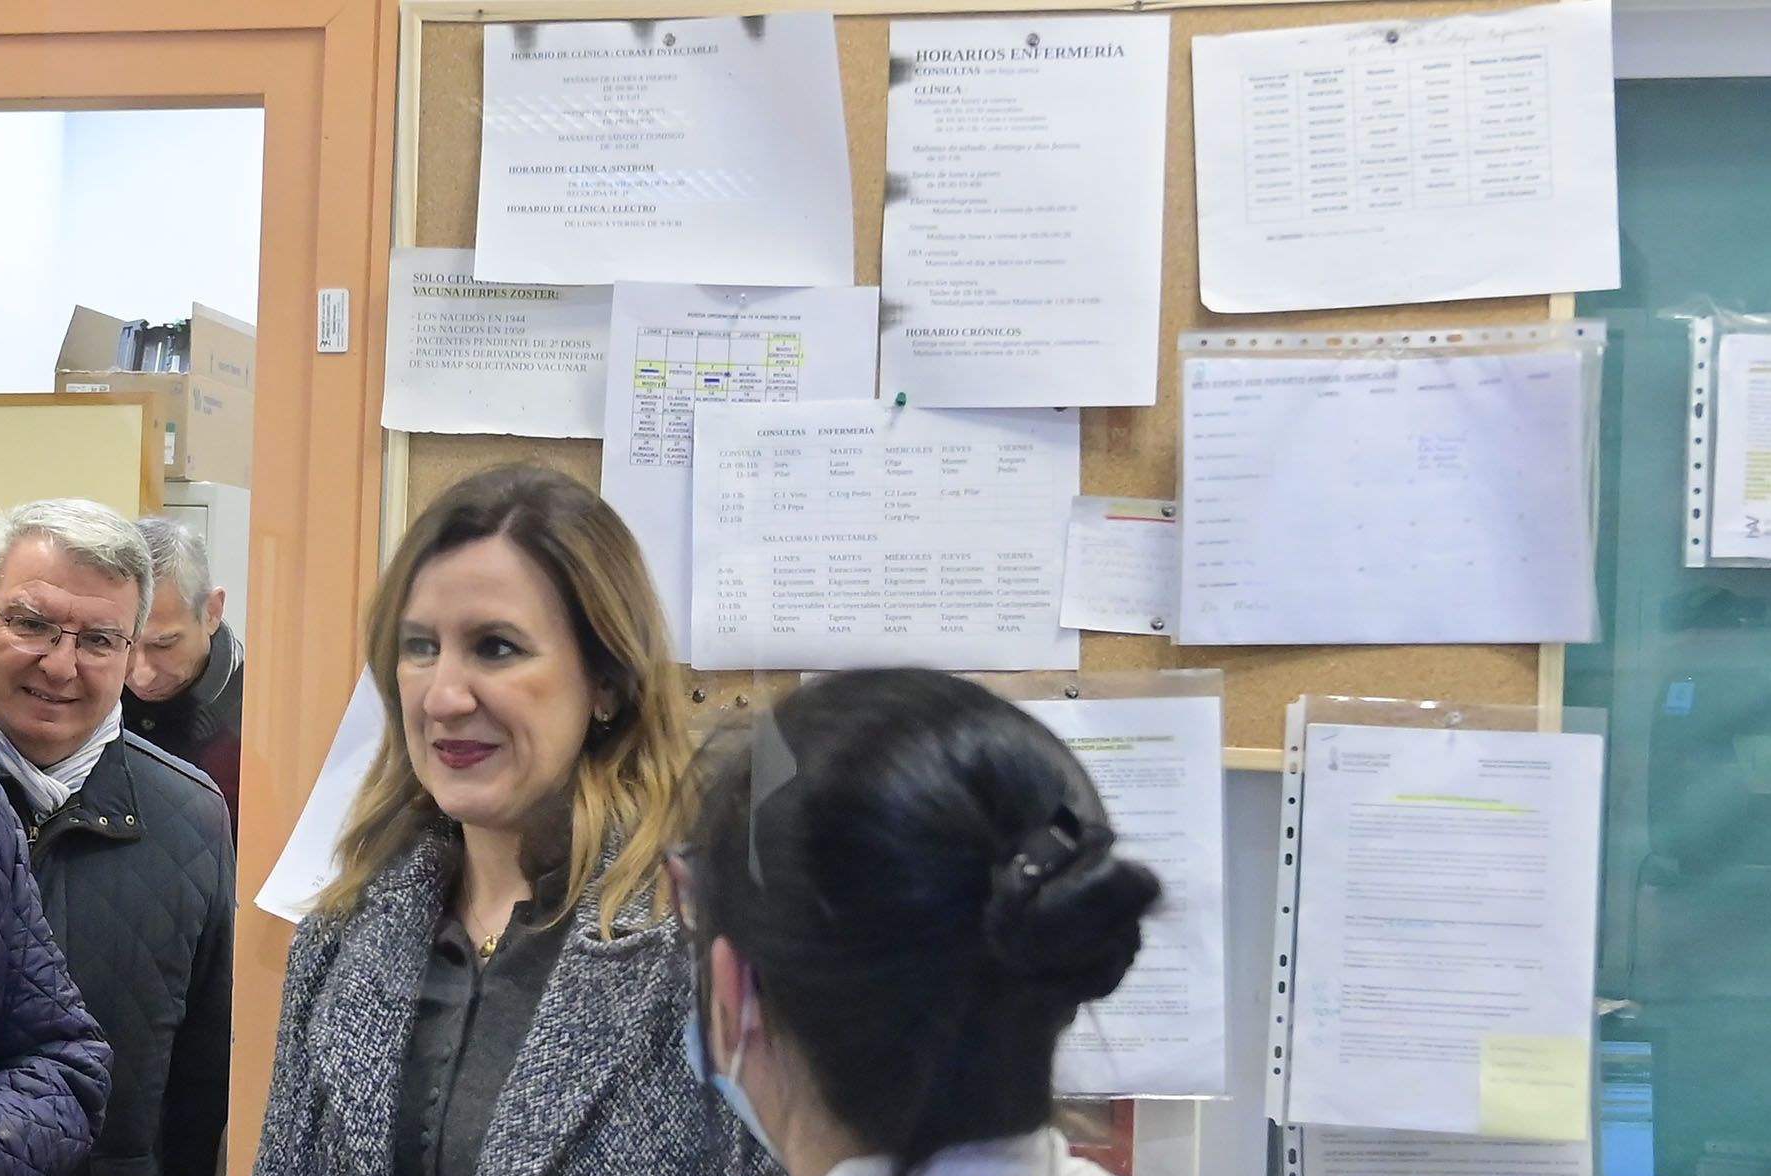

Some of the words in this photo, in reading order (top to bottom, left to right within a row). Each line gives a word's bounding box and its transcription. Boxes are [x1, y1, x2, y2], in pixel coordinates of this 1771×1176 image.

[511, 51, 555, 61] HORARIO
[557, 51, 568, 60] DE
[571, 49, 608, 59] CLÍNICA
[615, 49, 648, 58] CURAS
[657, 45, 720, 57] INYECTABLES
[916, 49, 1006, 63] HORARIOS
[1011, 45, 1126, 60] ENFERMERÍA
[914, 67, 981, 77] CONSULTAS
[914, 85, 962, 95] CLÍNICA
[509, 166, 552, 175] HORARIO
[554, 166, 566, 174] DE
[569, 164, 607, 174] CLÍNICA
[507, 204, 551, 214] HORARIO
[553, 205, 564, 213] DE
[567, 203, 606, 214] CLÍNICA
[612, 204, 657, 214] ELECTRO
[413, 273, 445, 284] SOLO
[448, 274, 484, 284] CITA
[413, 287, 460, 298] VACUNA
[462, 288, 507, 298] HERPES
[510, 289, 560, 300] ZOSTER:
[417, 312, 437, 322] LOS
[440, 313, 486, 322] NACIDOS
[488, 314, 502, 322] EN
[505, 315, 526, 324] 1944
[417, 325, 436, 334] LOS
[439, 325, 485, 335] NACIDOS
[488, 326, 502, 335] EN
[906, 328, 960, 338] HORARIO
[961, 326, 1022, 338] CRÓNICOS
[416, 336, 471, 346] PACIENTES
[473, 338, 530, 348] PENDIENTE
[533, 340, 546, 348] DE
[560, 340, 591, 349] DOSIS
[415, 348, 470, 358] PACIENTES
[473, 350, 531, 360] DERIVADOS
[534, 351, 556, 360] CON
[409, 360, 423, 369] DE
[426, 361, 440, 370] SU
[442, 361, 464, 370] MAP
[466, 361, 535, 372] SOLICITANDO
[537, 363, 588, 373] VACUNAR
[757, 429, 807, 438] CONSULTAS
[818, 427, 876, 436] ENFERMERÍA
[719, 450, 762, 458] CONSULTA
[774, 449, 802, 457] LUNES
[830, 448, 863, 456] MARTES
[762, 534, 784, 542] SALA
[773, 554, 800, 562] LUNES
